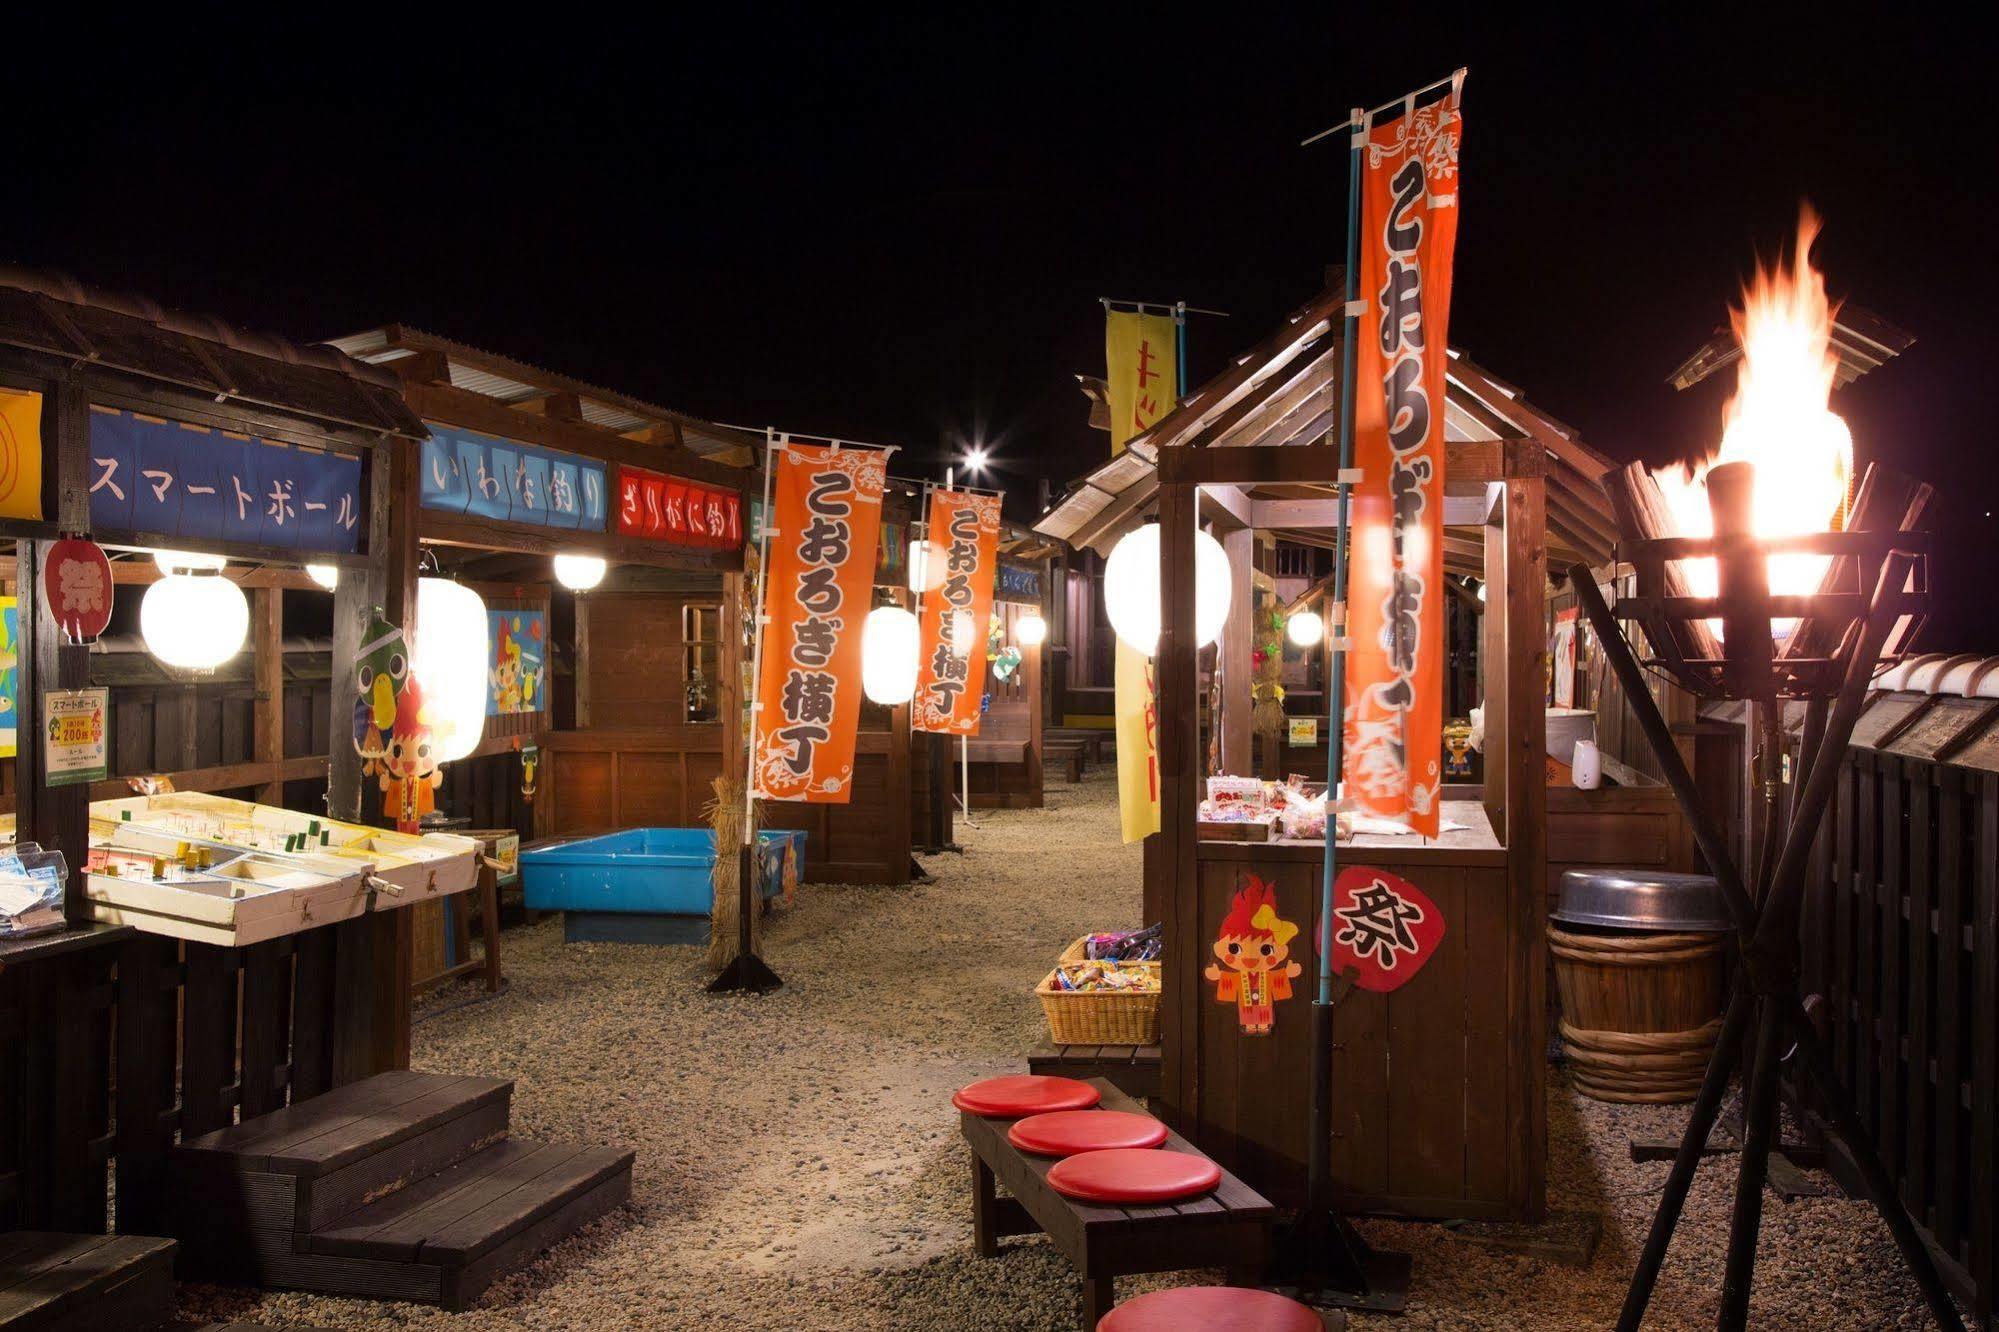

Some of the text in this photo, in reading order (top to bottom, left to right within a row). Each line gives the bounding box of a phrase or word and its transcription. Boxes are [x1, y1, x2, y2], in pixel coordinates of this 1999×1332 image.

[89, 457, 357, 532] スマートボール
[432, 455, 599, 521] いわな釣り
[621, 483, 739, 541] ざりがに釣り
[776, 470, 852, 777] こおろぎ横丁
[53, 699, 98, 711] スマートボール
[1333, 878, 1425, 971] 祭
